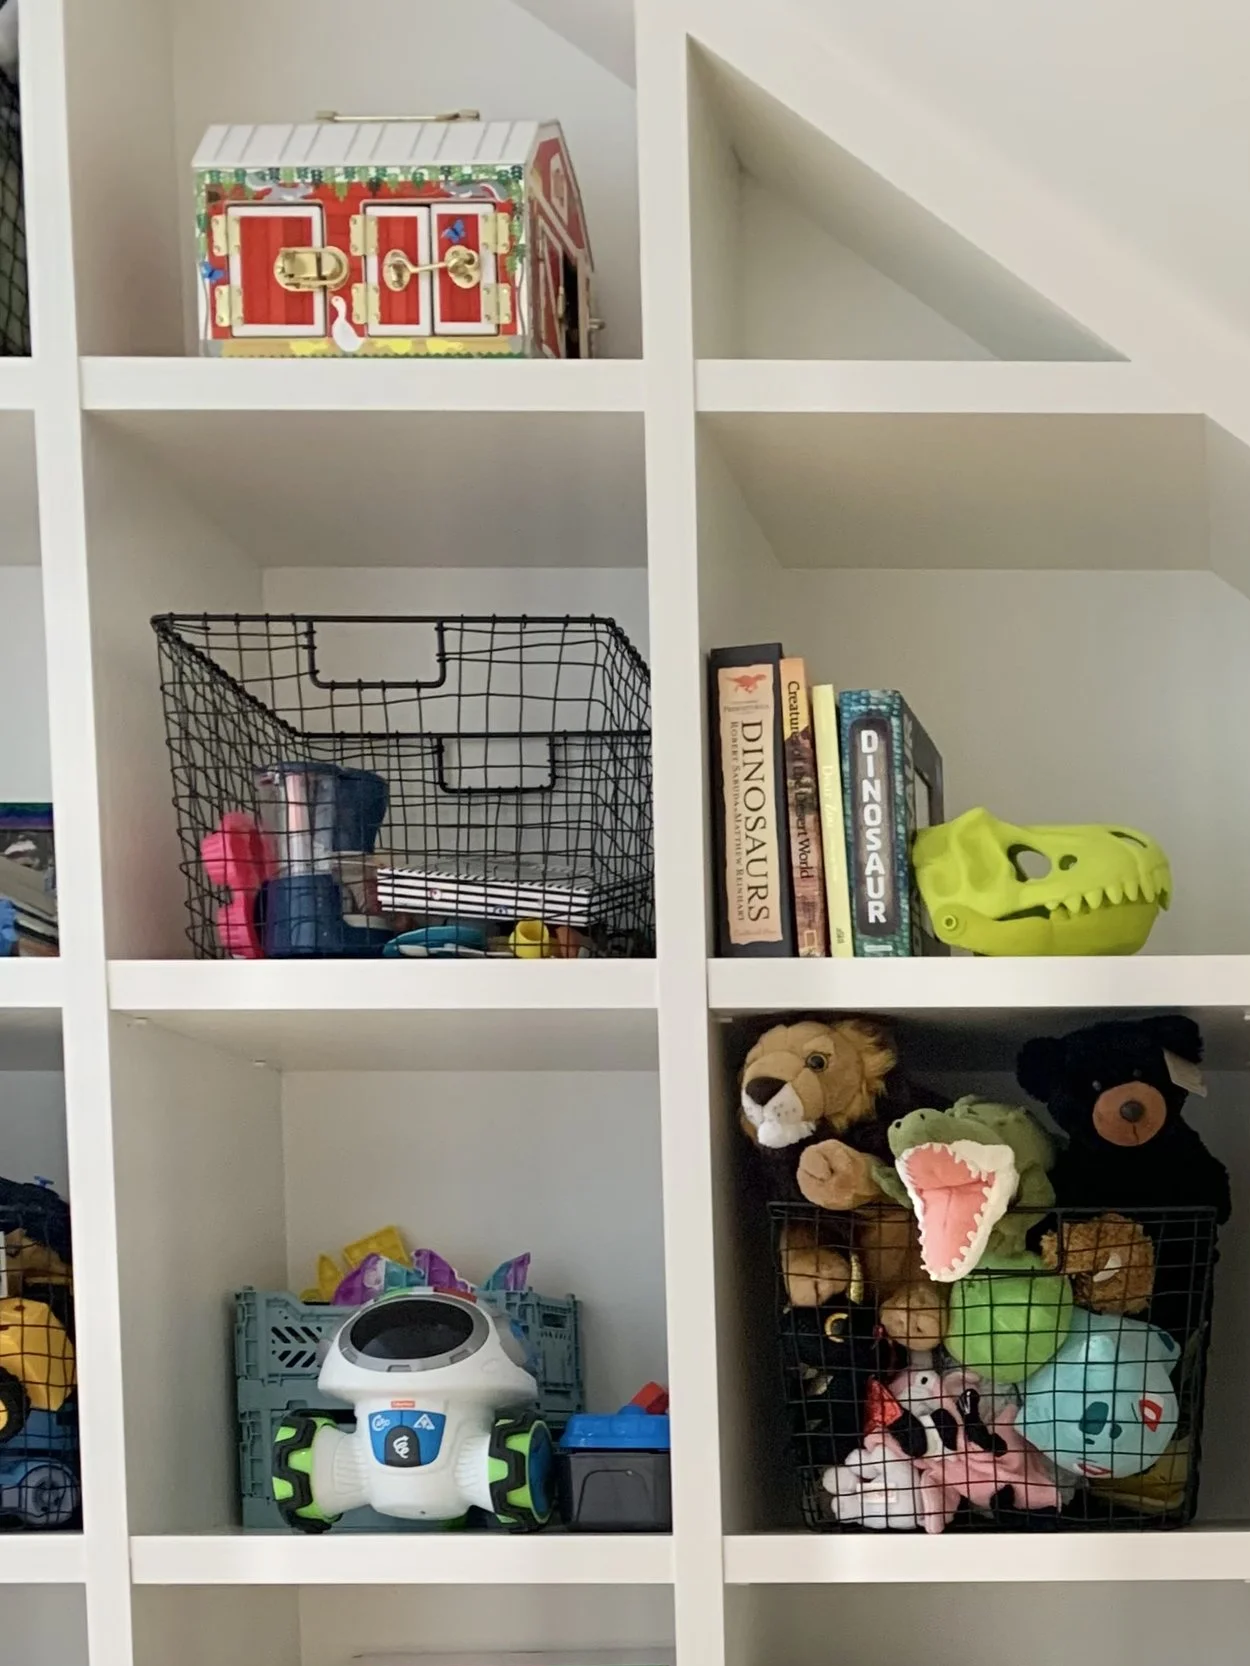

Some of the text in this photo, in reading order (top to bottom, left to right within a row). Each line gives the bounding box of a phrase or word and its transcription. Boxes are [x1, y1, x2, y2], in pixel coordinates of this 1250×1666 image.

[741, 720, 770, 922] DINOSAURS
[798, 838, 814, 879] World
[860, 730, 887, 924] DINOSAUR
